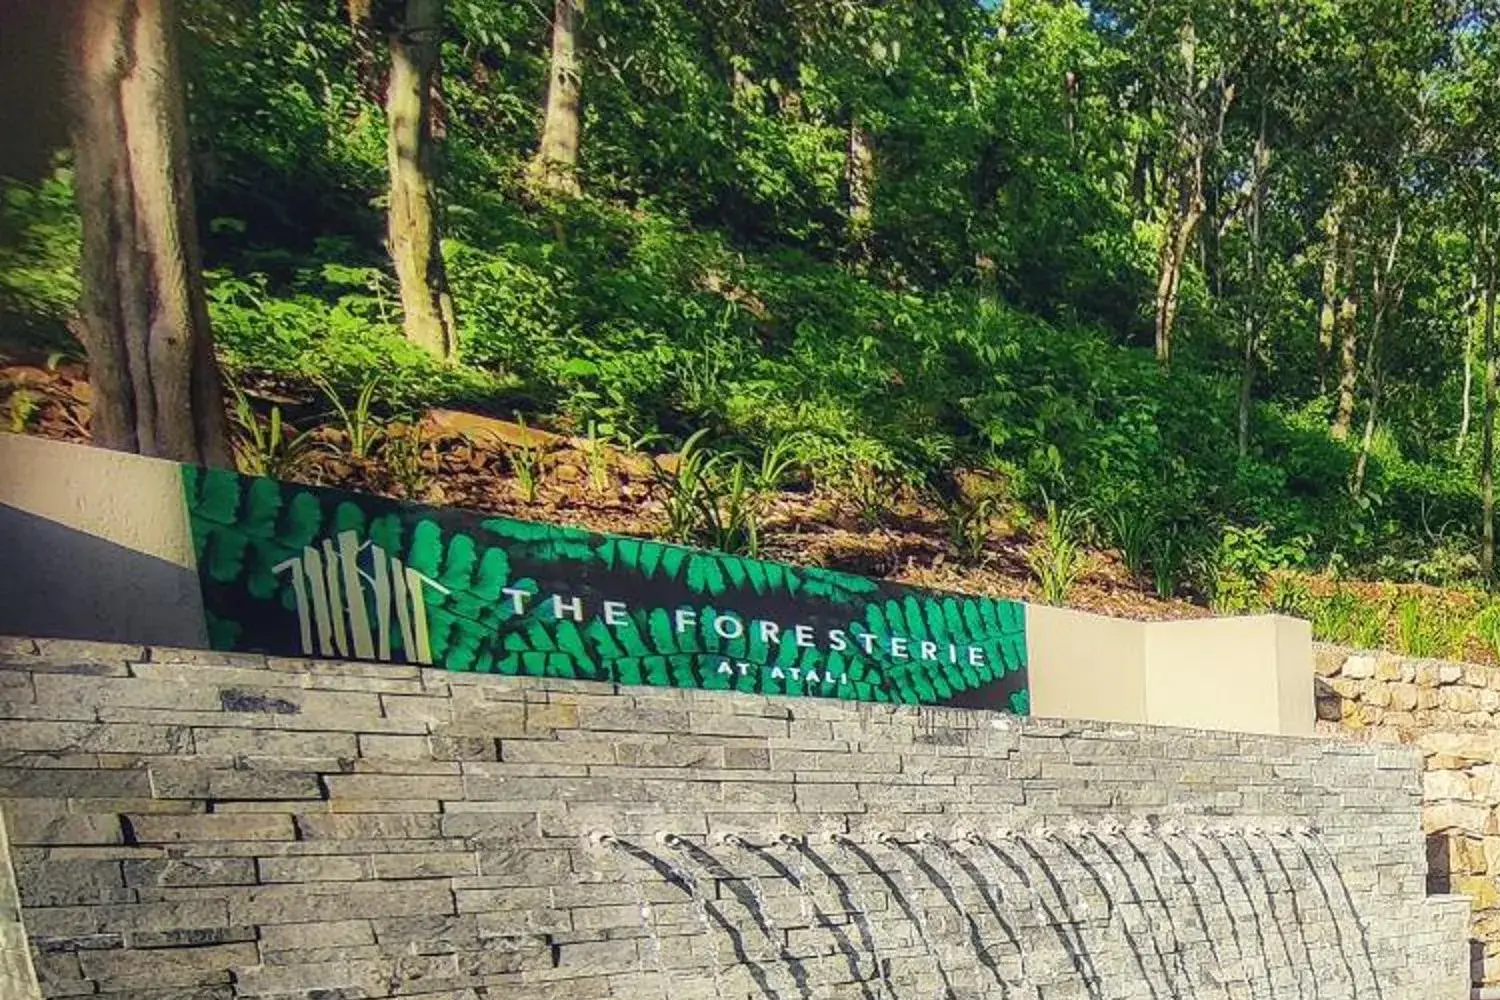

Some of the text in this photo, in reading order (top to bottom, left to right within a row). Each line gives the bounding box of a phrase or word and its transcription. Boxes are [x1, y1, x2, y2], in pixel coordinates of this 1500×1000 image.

[502, 587, 985, 667] THE FORESTERIE
[717, 661, 848, 685] AT ATALI
